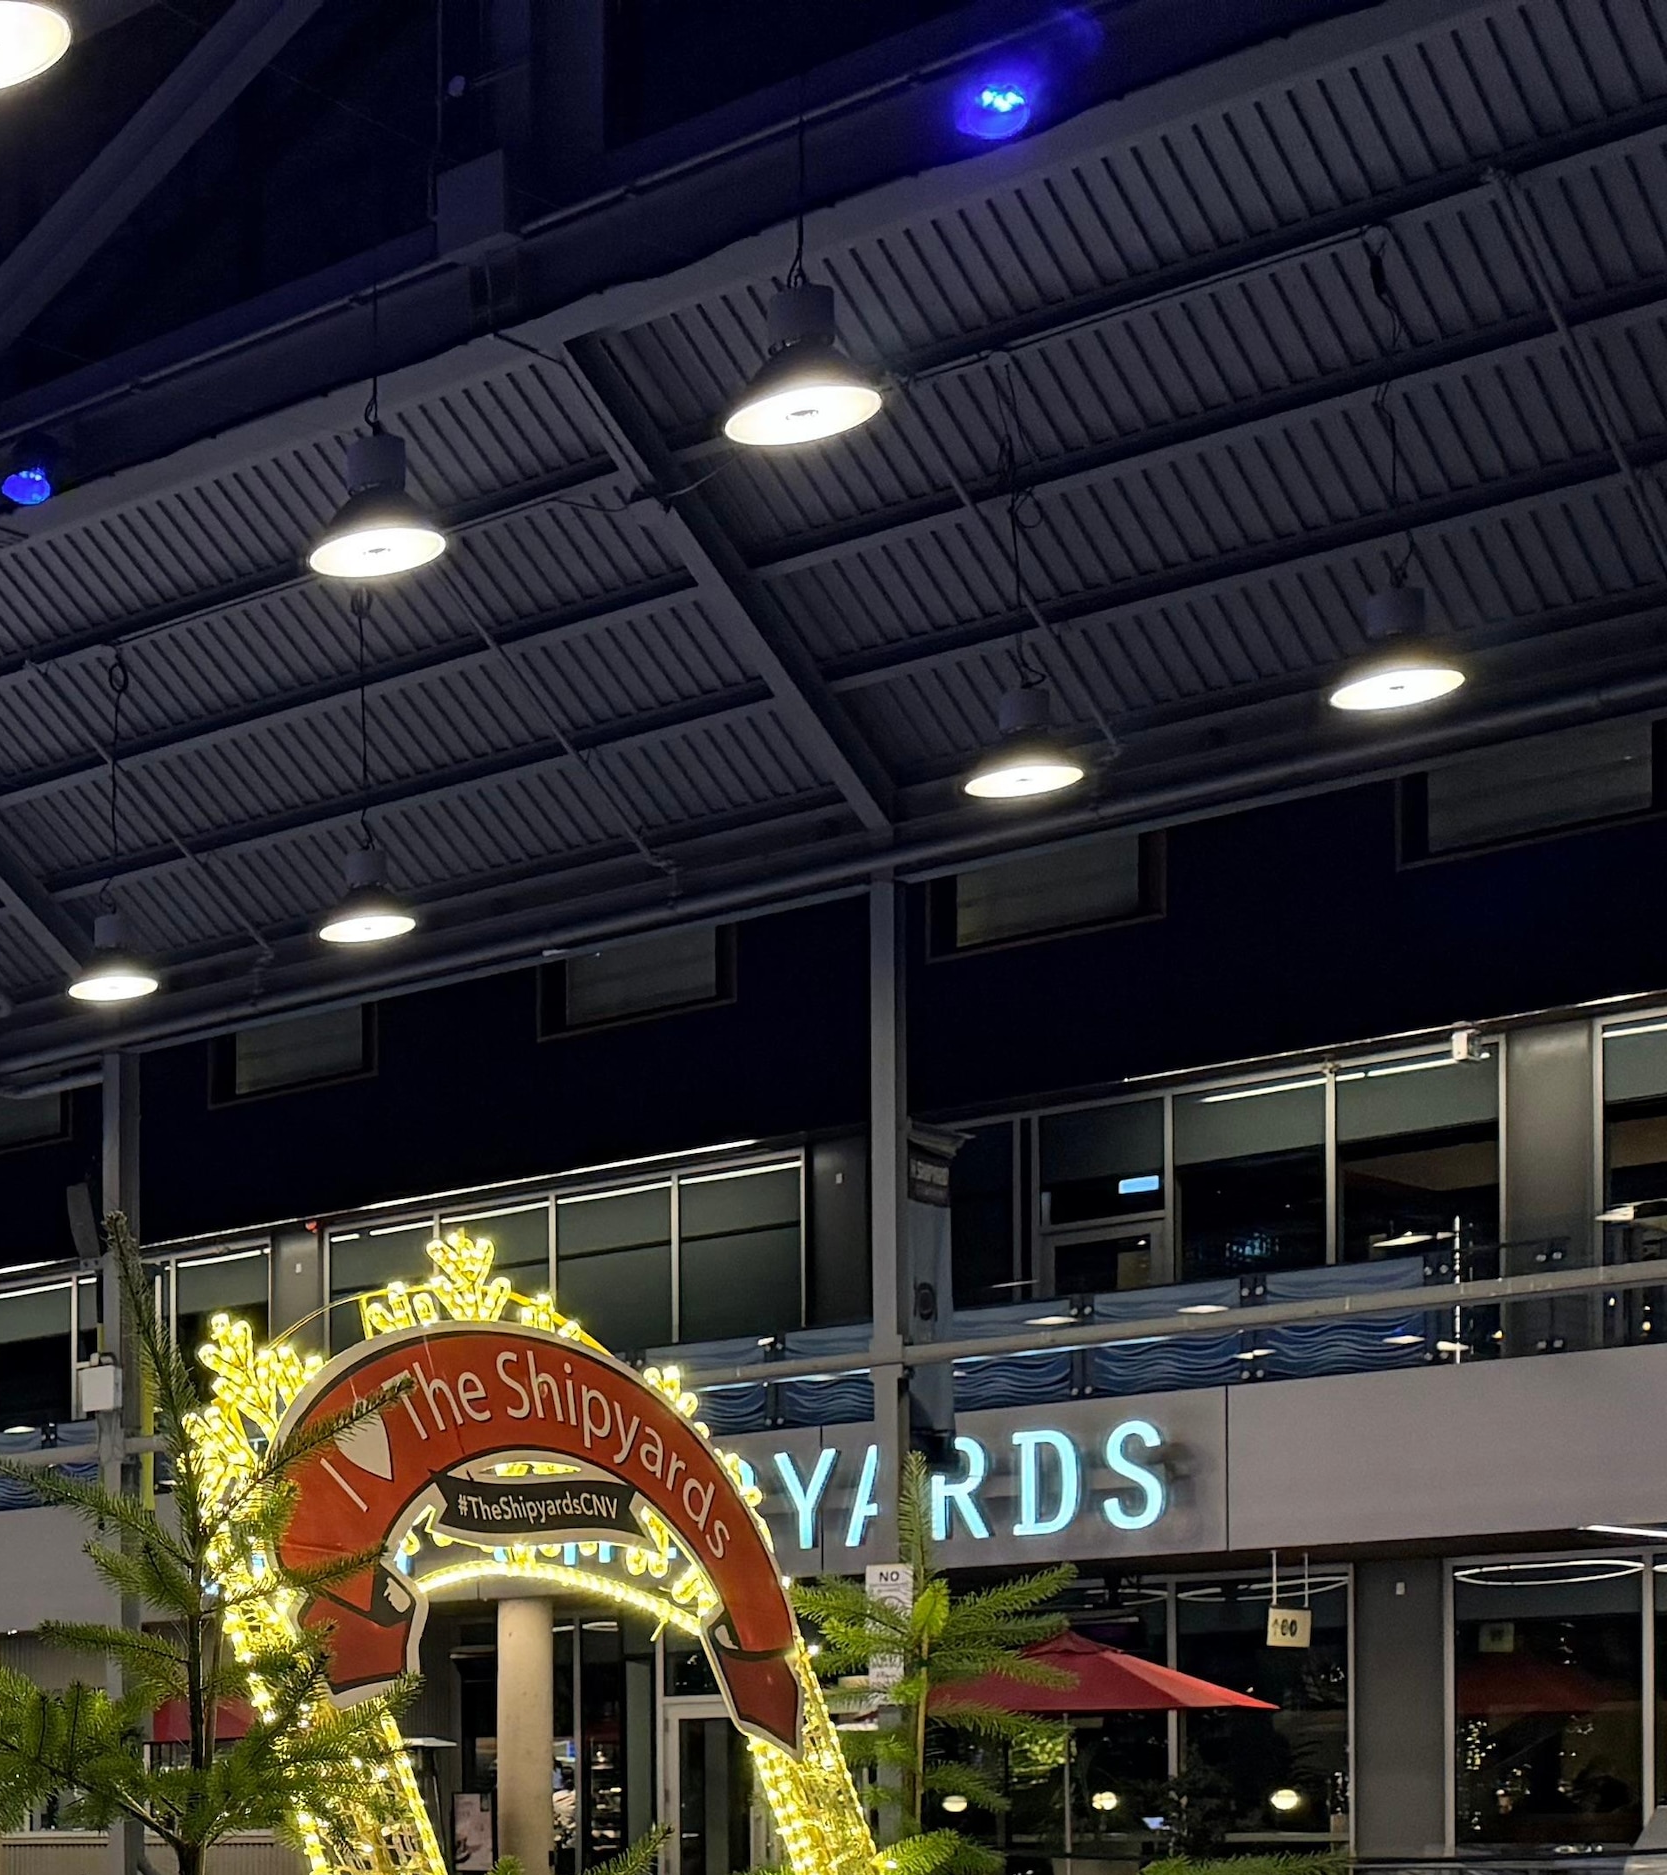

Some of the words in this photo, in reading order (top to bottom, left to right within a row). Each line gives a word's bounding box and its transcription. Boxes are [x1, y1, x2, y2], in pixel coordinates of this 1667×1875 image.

[319, 1456, 369, 1514] I
[380, 1360, 493, 1441] The
[495, 1349, 732, 1560] Shipyards
[457, 1491, 619, 1524] #TheShipyardsCNV
[879, 1571, 900, 1582] NO
